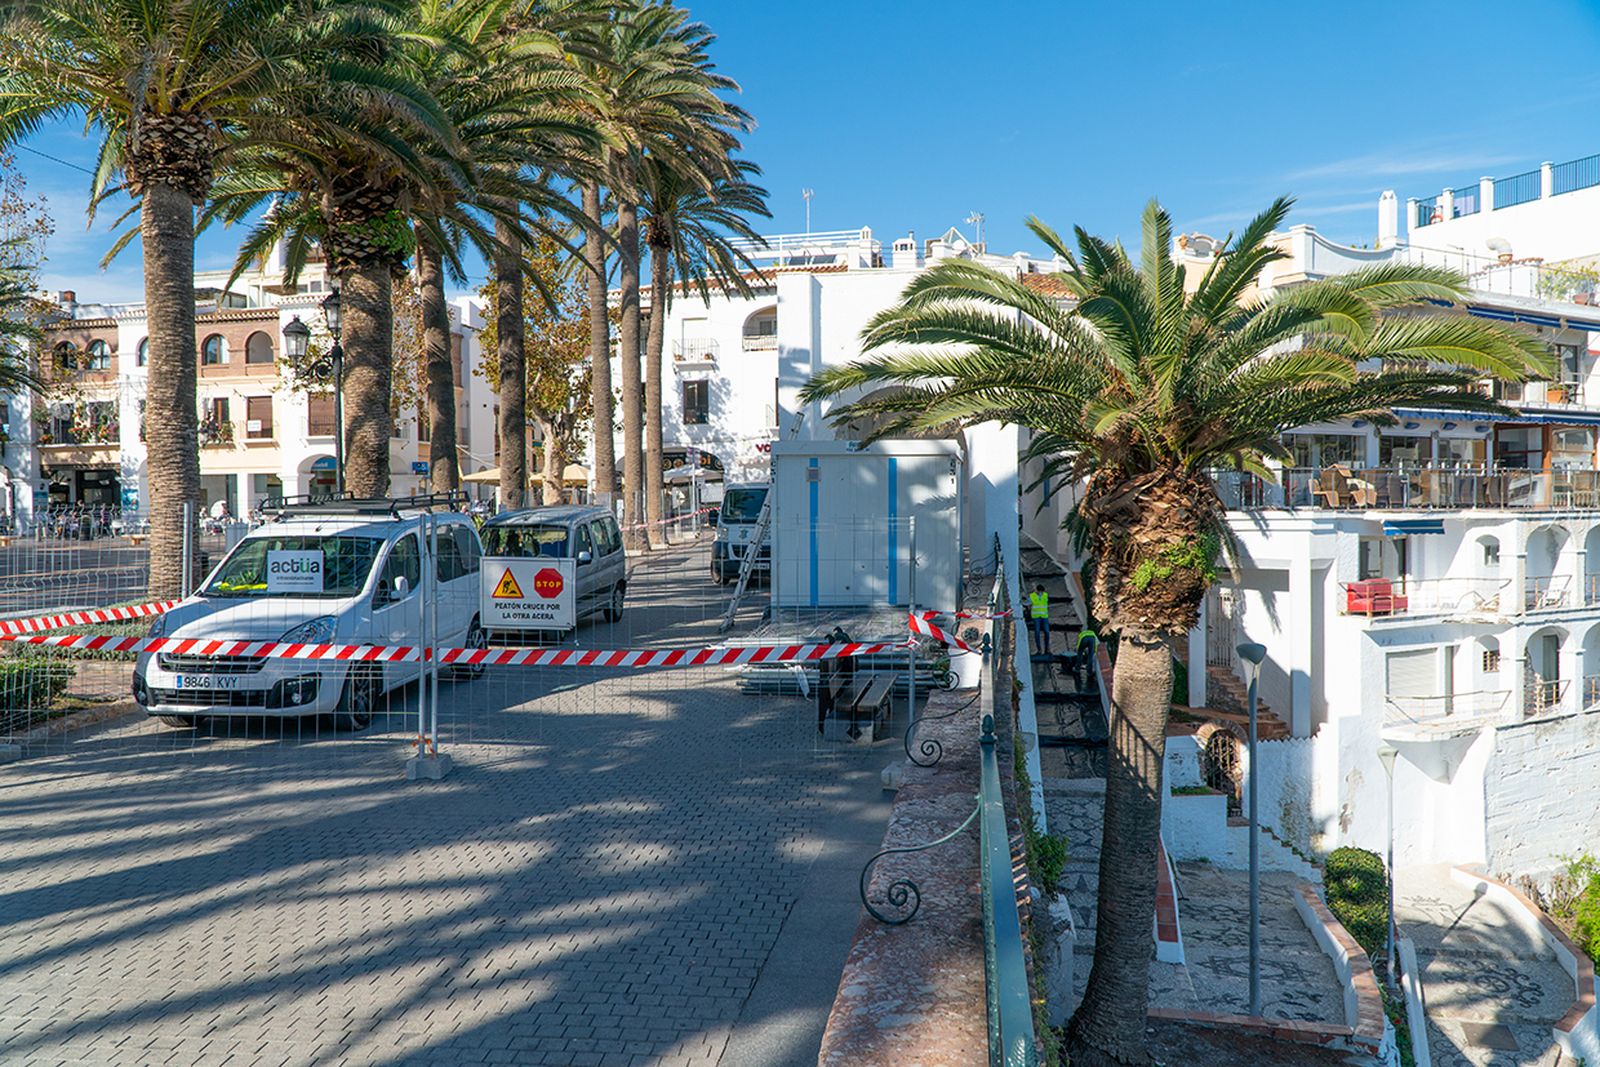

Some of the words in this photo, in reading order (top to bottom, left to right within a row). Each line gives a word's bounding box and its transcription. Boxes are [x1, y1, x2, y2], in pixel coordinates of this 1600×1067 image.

[271, 558, 320, 573] actüa
[495, 602, 521, 610] PEATÓN
[184, 676, 210, 688] 9846
[217, 676, 238, 688] KVY
